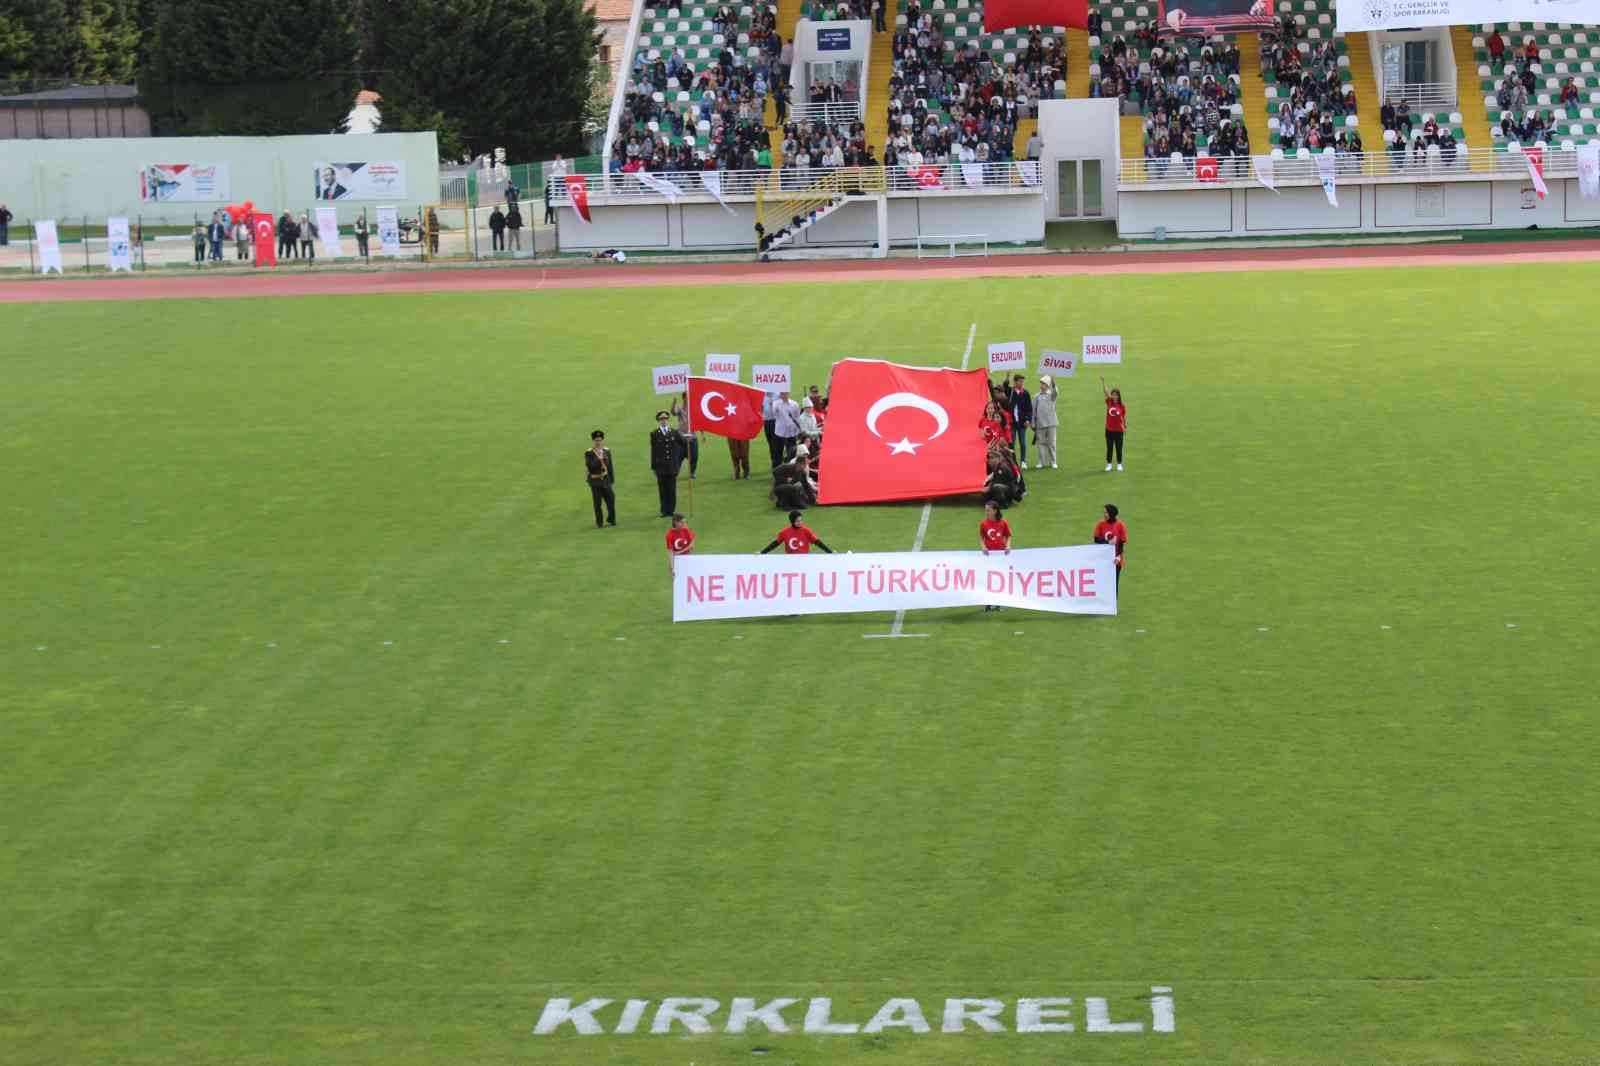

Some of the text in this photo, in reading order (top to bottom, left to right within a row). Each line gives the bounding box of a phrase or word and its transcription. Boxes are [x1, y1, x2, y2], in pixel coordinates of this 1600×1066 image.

[1086, 344, 1118, 355] SAMSUN
[991, 350, 1023, 363] ERZURUM
[708, 362, 737, 373] ANKARA
[1043, 357, 1073, 370] SİVAS
[755, 373, 787, 385] HAVZA
[686, 564, 1097, 603] NE MUTLU TÜRKÜM DİYENE
[532, 985, 1175, 1034] KIRKLARELİ
